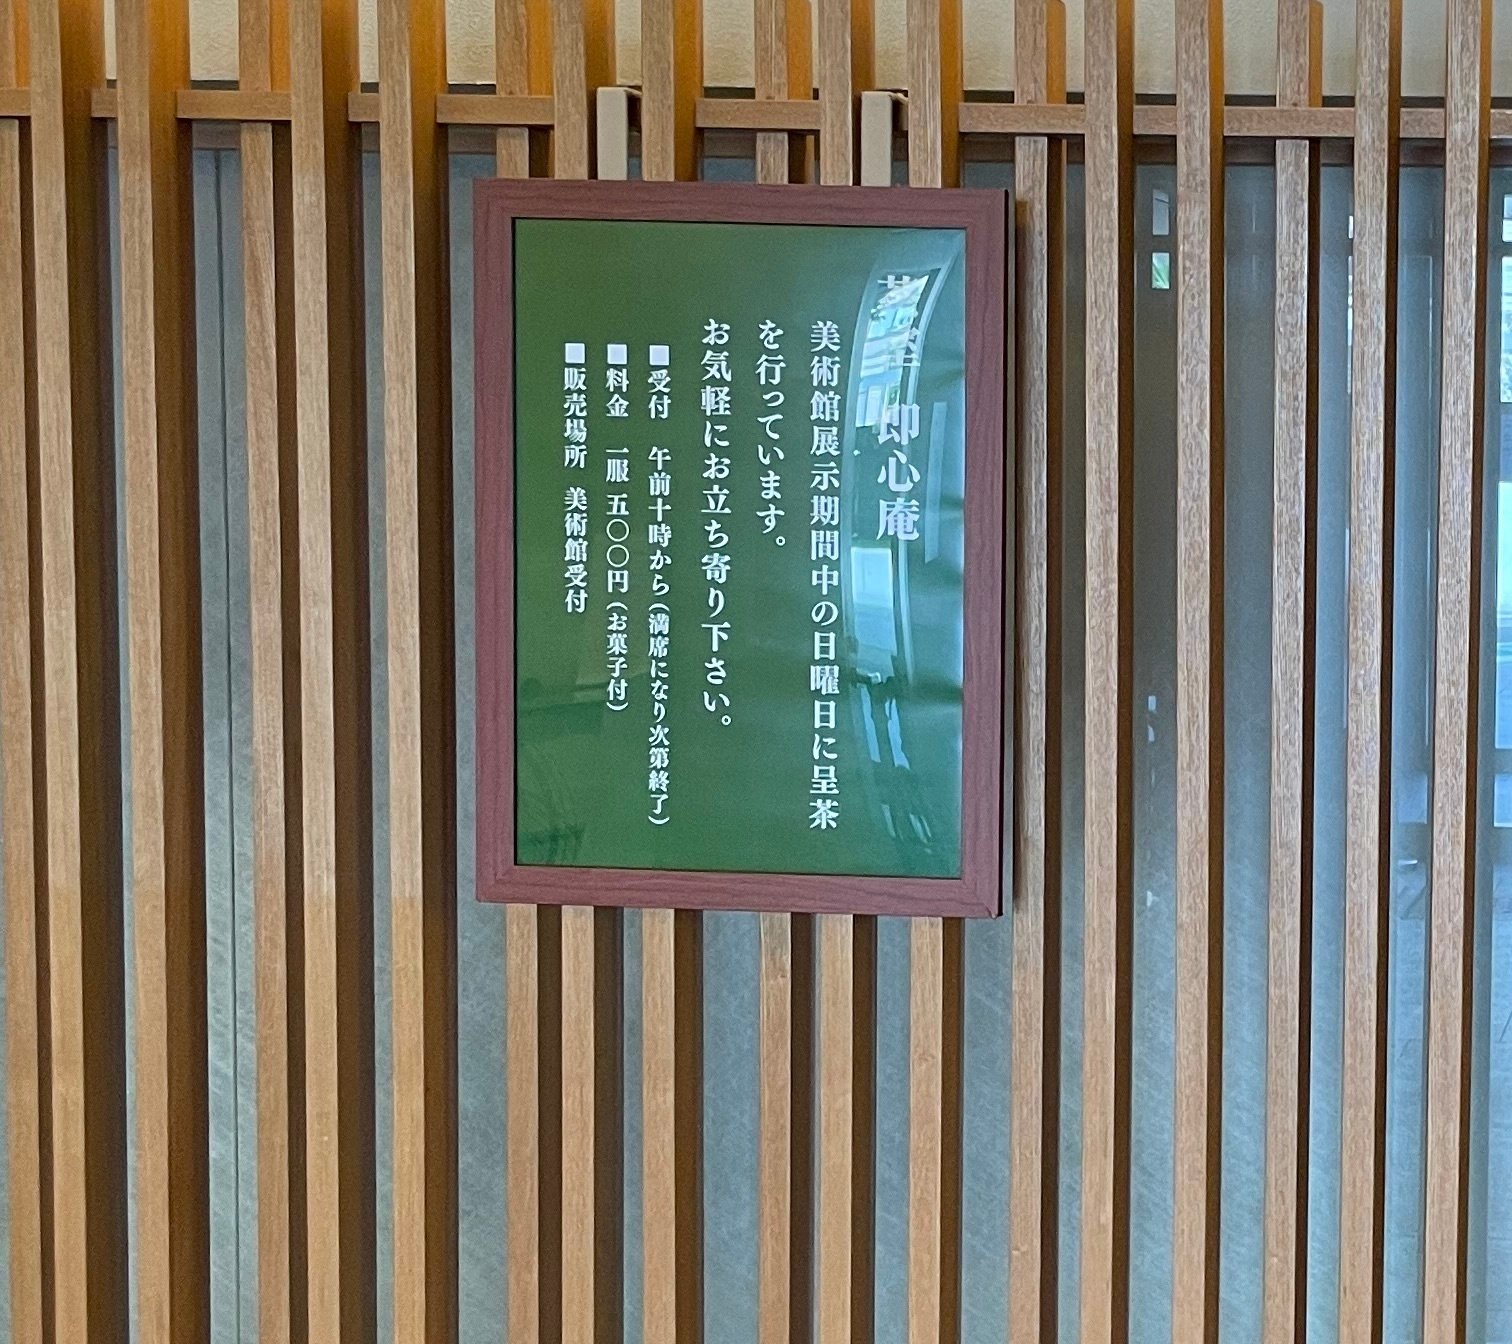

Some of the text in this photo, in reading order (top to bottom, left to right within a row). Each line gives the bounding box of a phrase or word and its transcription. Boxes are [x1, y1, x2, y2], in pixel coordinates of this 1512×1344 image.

[700, 318, 732, 726] お気軽にお立ち寄り下さい。
[755, 319, 787, 547] を行っています。
[876, 402, 921, 541] 即心庵
[563, 486, 588, 613] 美術館受付
[809, 320, 841, 830] 美術館展示期間中の日曜日に呈茶
